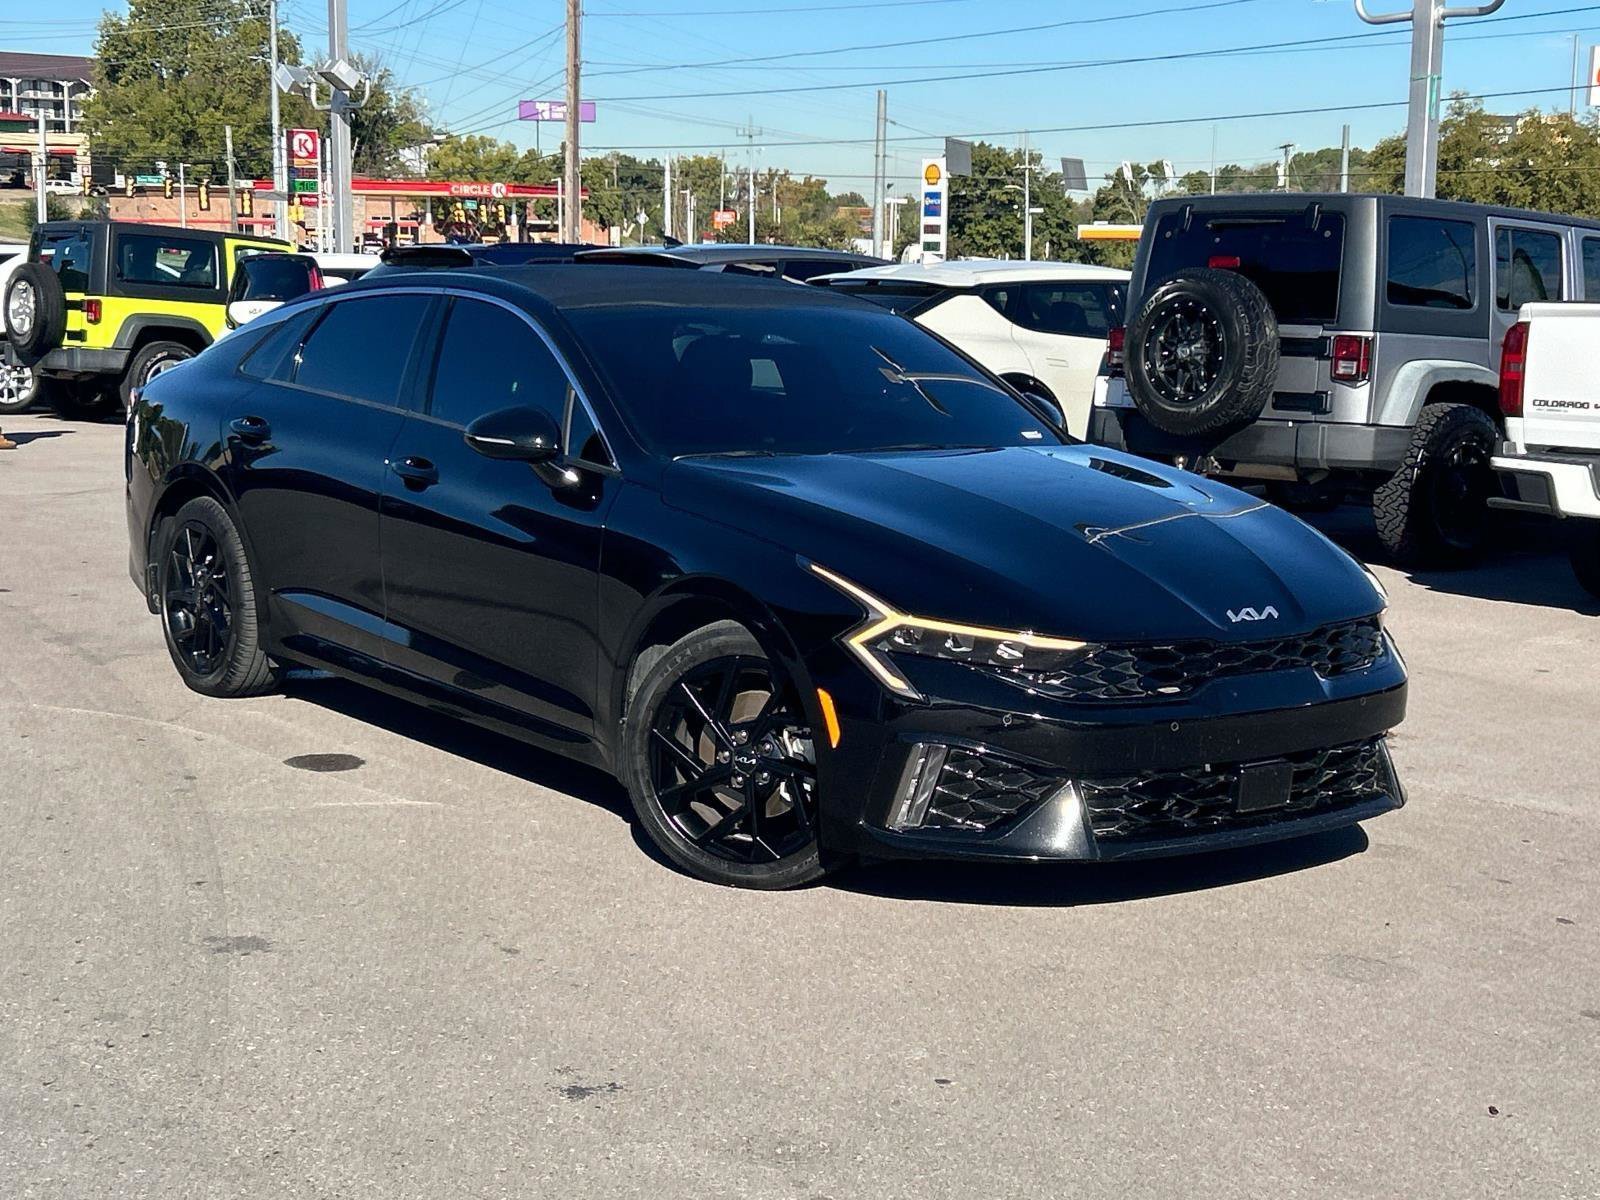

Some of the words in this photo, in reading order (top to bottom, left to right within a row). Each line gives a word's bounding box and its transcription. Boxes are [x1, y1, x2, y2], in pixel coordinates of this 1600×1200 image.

[297, 136, 312, 156] K
[451, 184, 491, 196] CIRCLE
[1532, 399, 1590, 409] COLORADO
[1226, 606, 1279, 622] KIA
